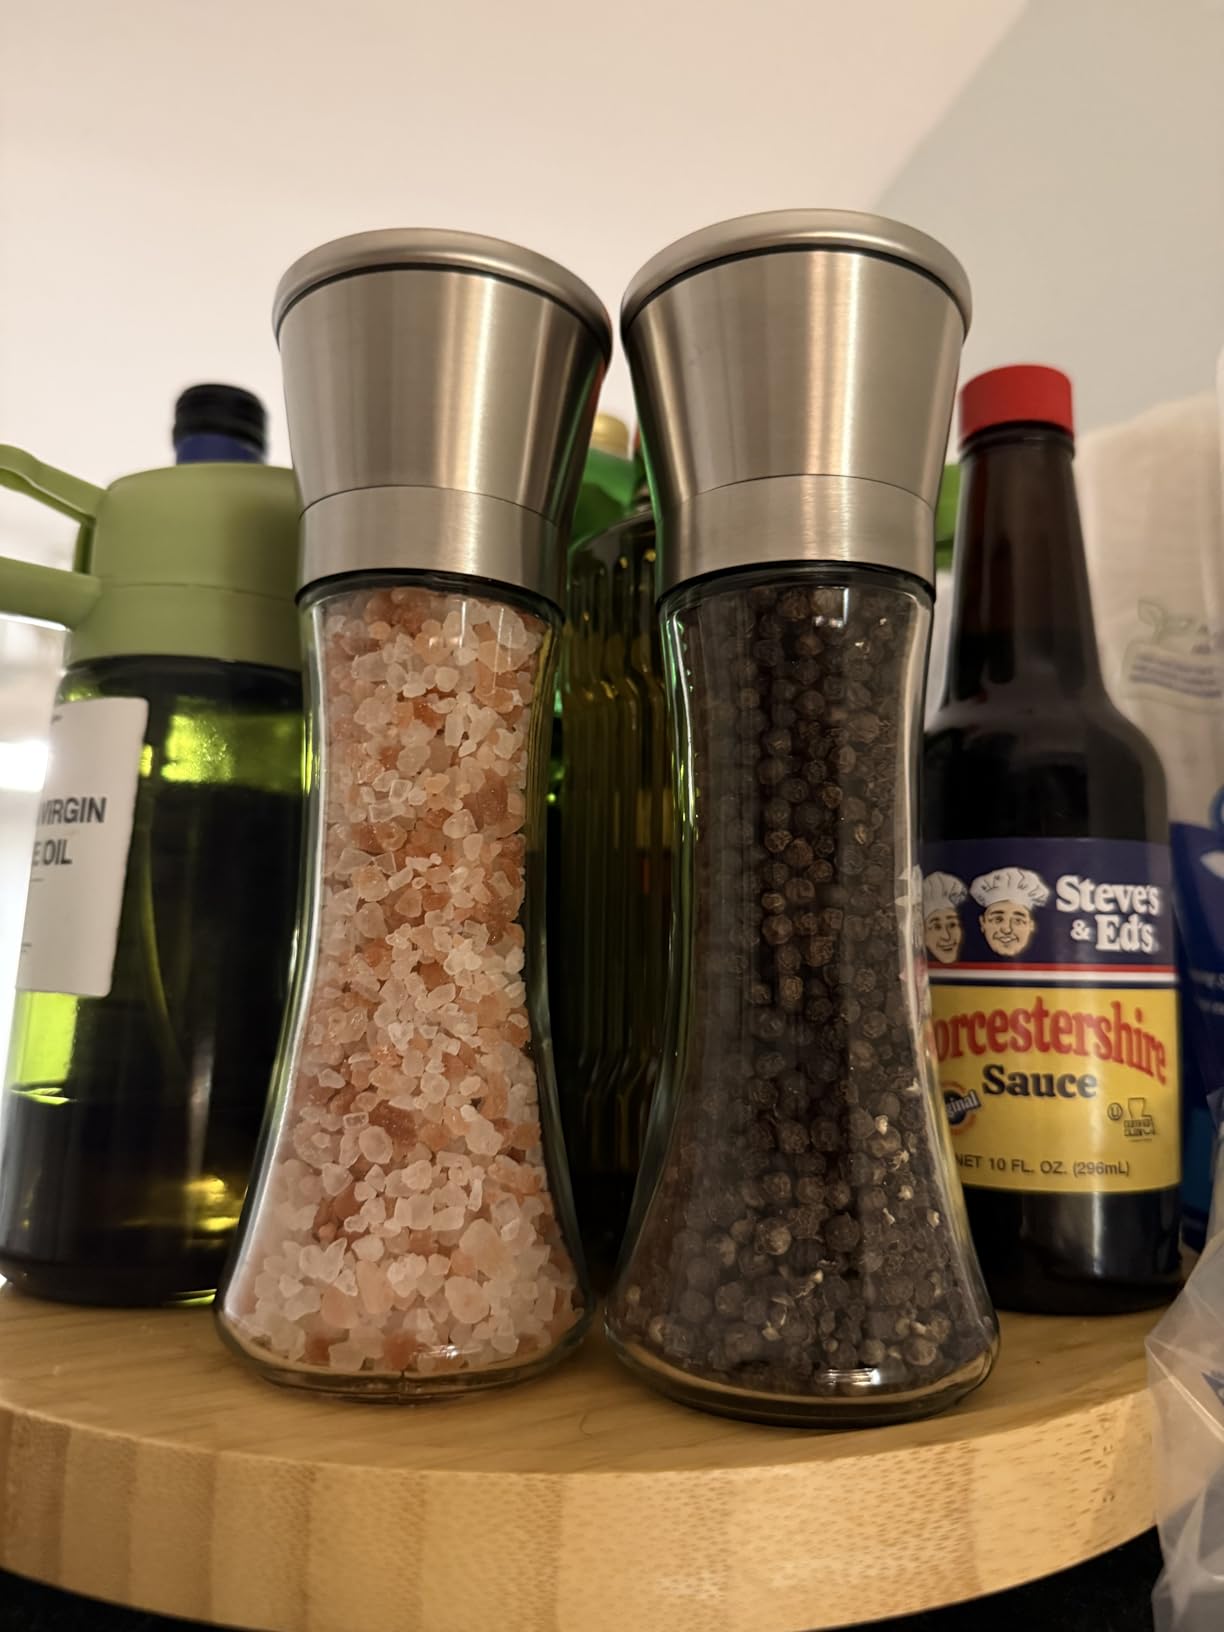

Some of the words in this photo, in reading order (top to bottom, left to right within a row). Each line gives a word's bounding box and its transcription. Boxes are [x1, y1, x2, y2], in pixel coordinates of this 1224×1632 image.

[43, 838, 73, 866] OIL
[1056, 874, 1160, 916] Steve's
[1070, 919, 1091, 941] &
[932, 995, 1167, 1087] orcestershire
[982, 1063, 1099, 1099] Sauce
[955, 1151, 984, 1169] NET
[988, 1157, 1007, 1172] 10
[1011, 1158, 1035, 1174] FL.
[1040, 1160, 1067, 1175] OZ.
[1072, 1160, 1130, 1178] (296mL)
